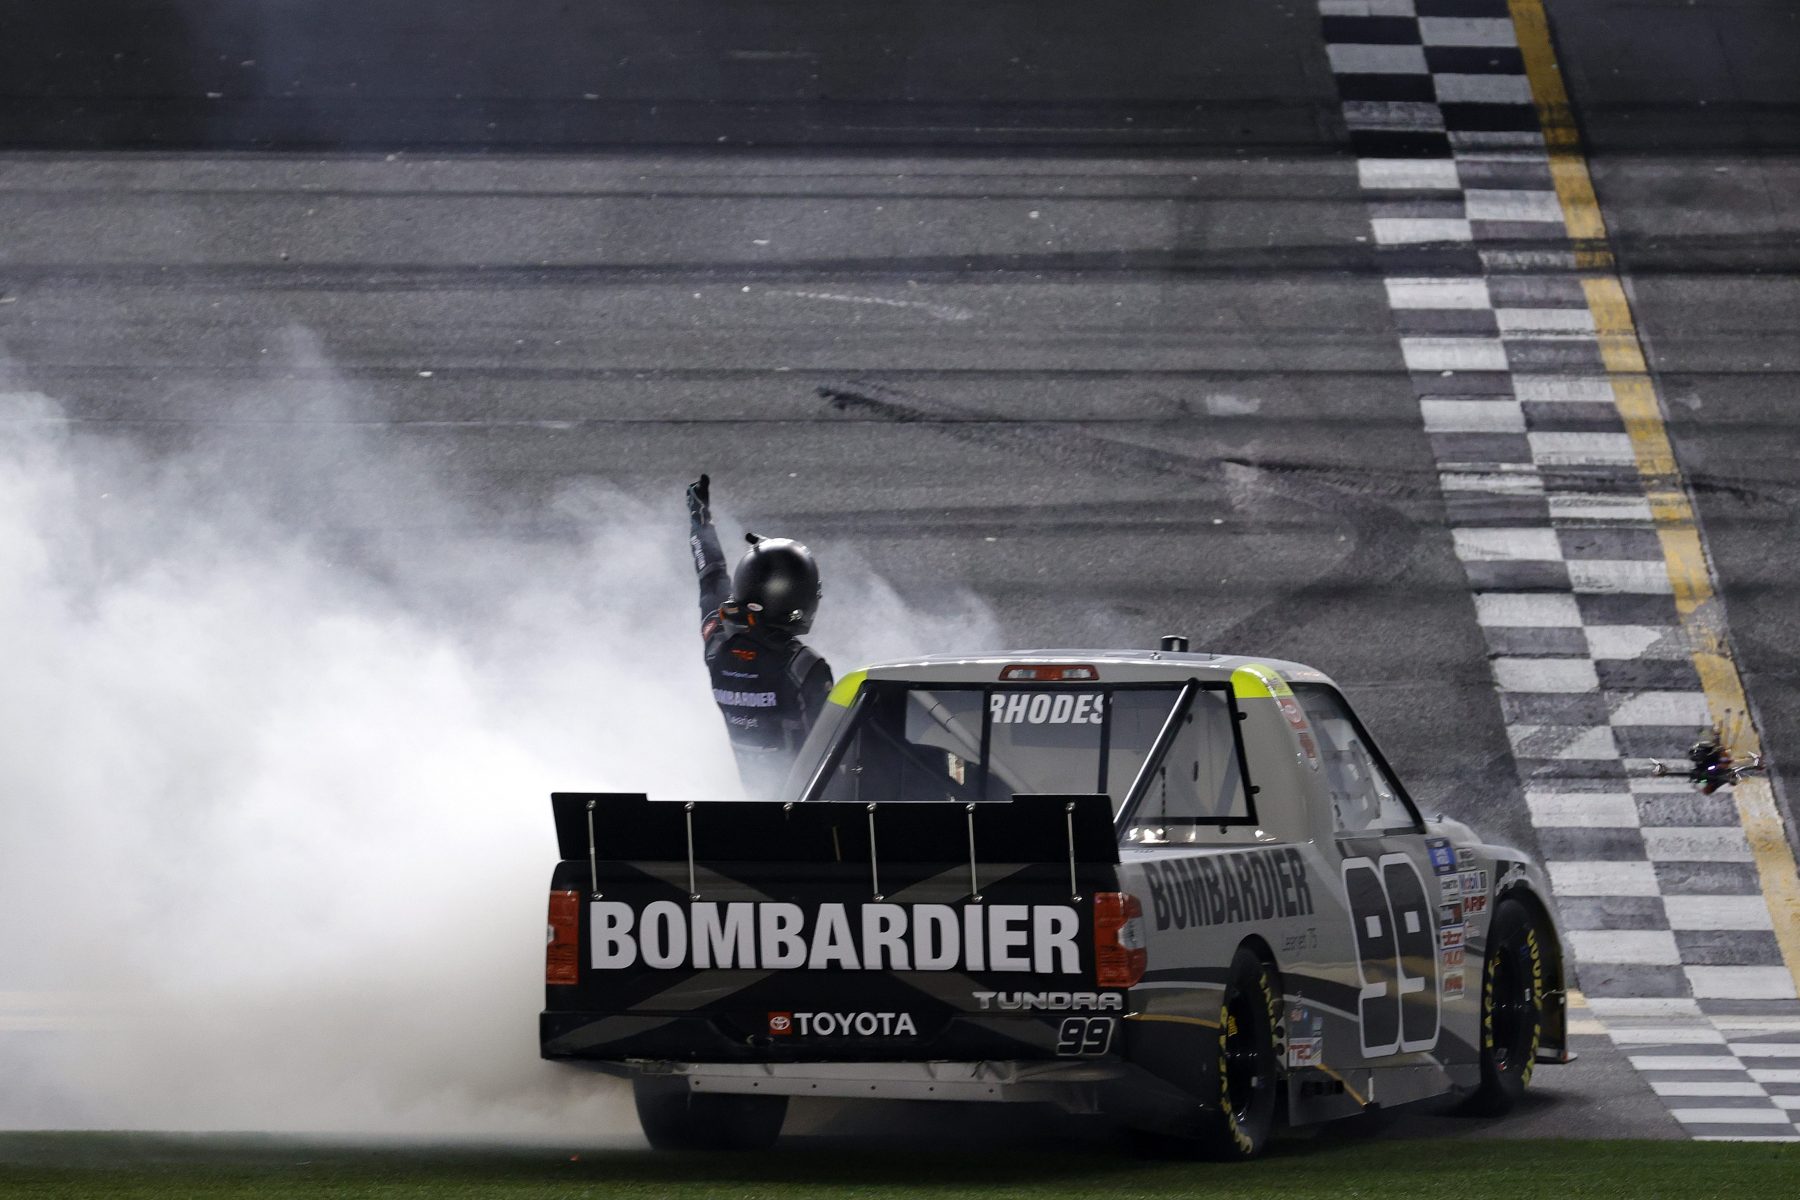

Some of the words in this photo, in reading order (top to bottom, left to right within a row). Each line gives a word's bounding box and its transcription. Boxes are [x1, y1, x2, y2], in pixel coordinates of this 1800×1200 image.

[990, 693, 1110, 725] RHODES
[1142, 848, 1314, 931] BOMBARDIER
[590, 900, 1082, 974] BOMBARDIER
[1341, 852, 1441, 1058] 99
[972, 992, 1122, 1010] TUNDRA
[794, 1012, 917, 1036] TOYOTA
[1056, 1016, 1116, 1056] 99
